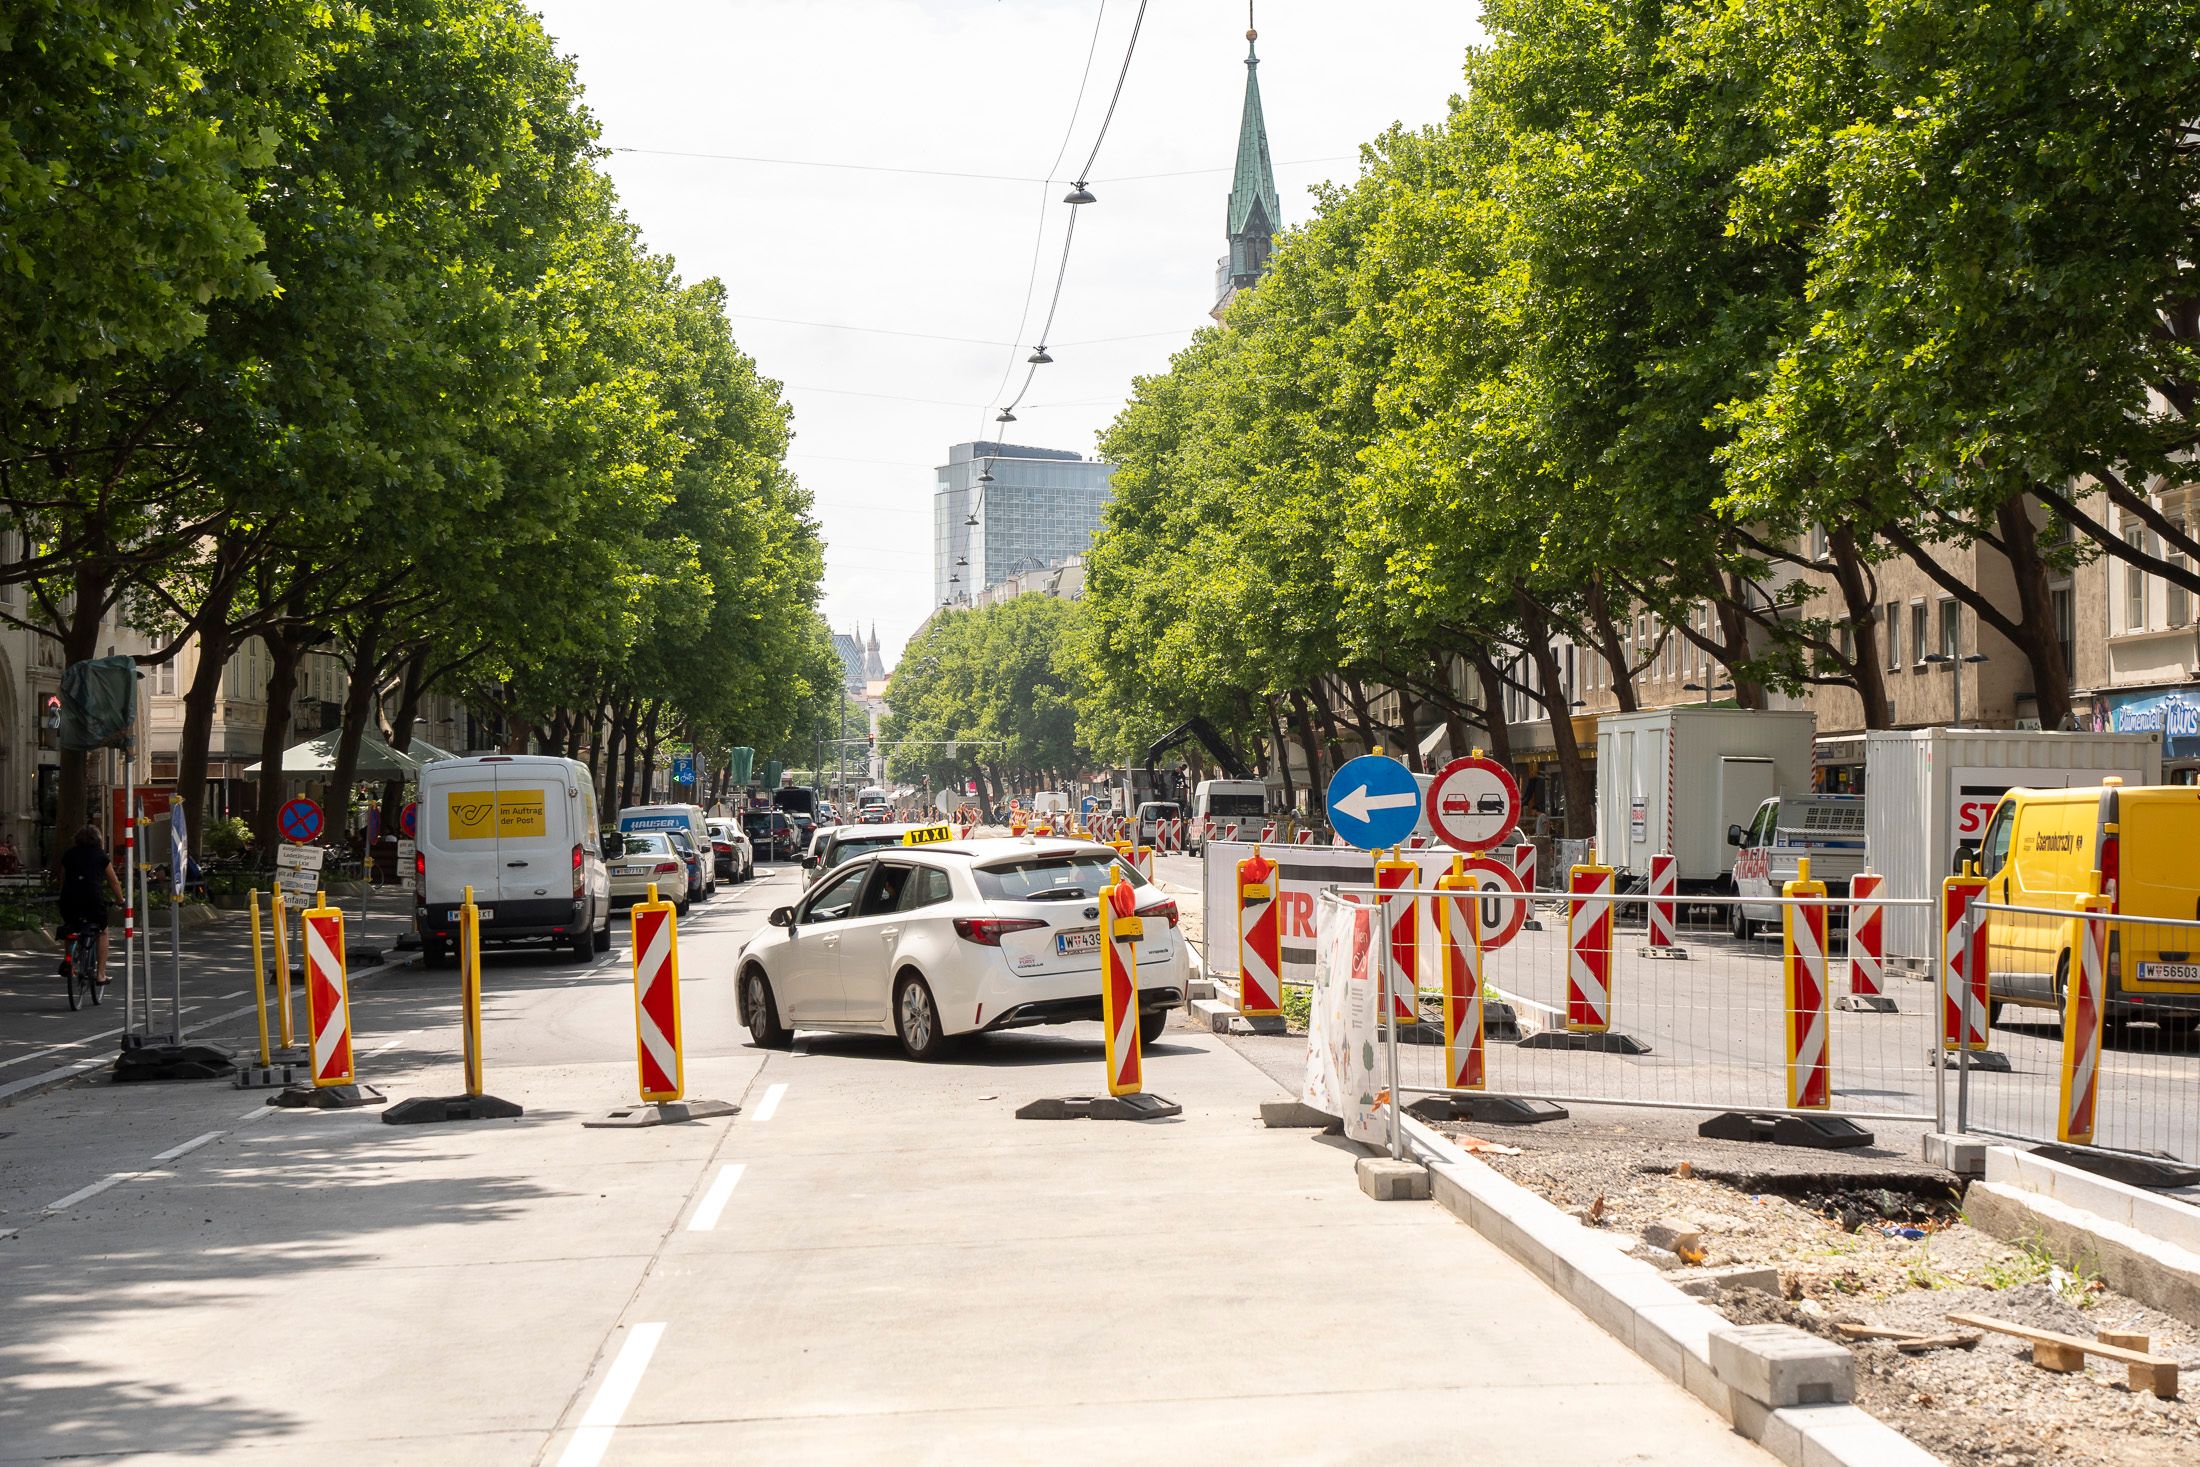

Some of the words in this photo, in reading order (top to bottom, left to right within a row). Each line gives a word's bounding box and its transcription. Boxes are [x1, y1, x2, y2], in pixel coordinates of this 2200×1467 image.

[2165, 696, 2199, 736] Twins
[512, 807, 542, 815] Auftrag
[1959, 801, 1998, 832] ST
[501, 817, 513, 825] der
[631, 819, 675, 829] HAUSER
[912, 828, 948, 842] TAXI
[1481, 881, 1501, 929] 0
[1065, 936, 1074, 948] W
[1082, 933, 1101, 947] 439
[2146, 965, 2155, 976] W
[2163, 966, 2200, 978] 56503
